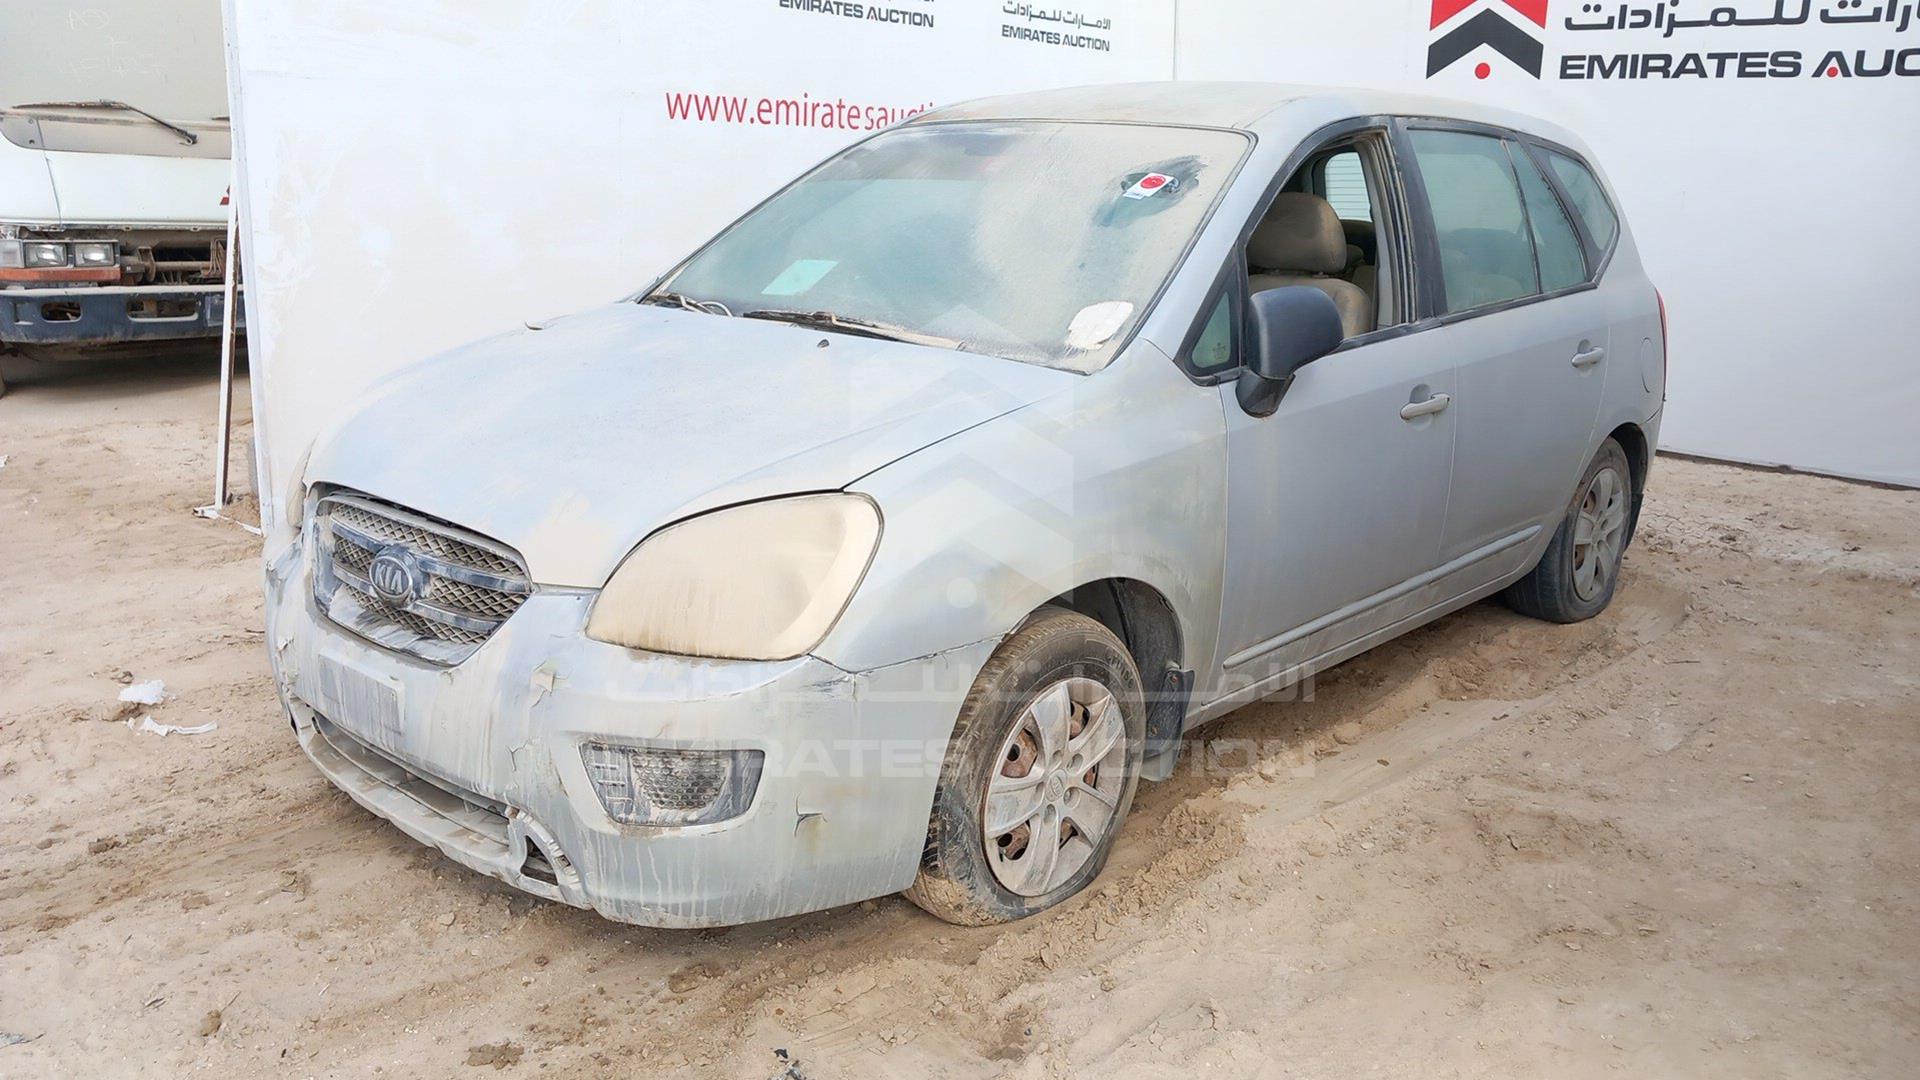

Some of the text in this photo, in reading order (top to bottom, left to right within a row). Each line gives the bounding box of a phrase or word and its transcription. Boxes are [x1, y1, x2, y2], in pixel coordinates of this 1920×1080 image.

[779, 0, 934, 28] EMIRATES AUCTION
[1001, 24, 1110, 52] EMIRATES AUCTION
[1559, 51, 1802, 79] EMIRATES
[374, 562, 403, 595] KIA
